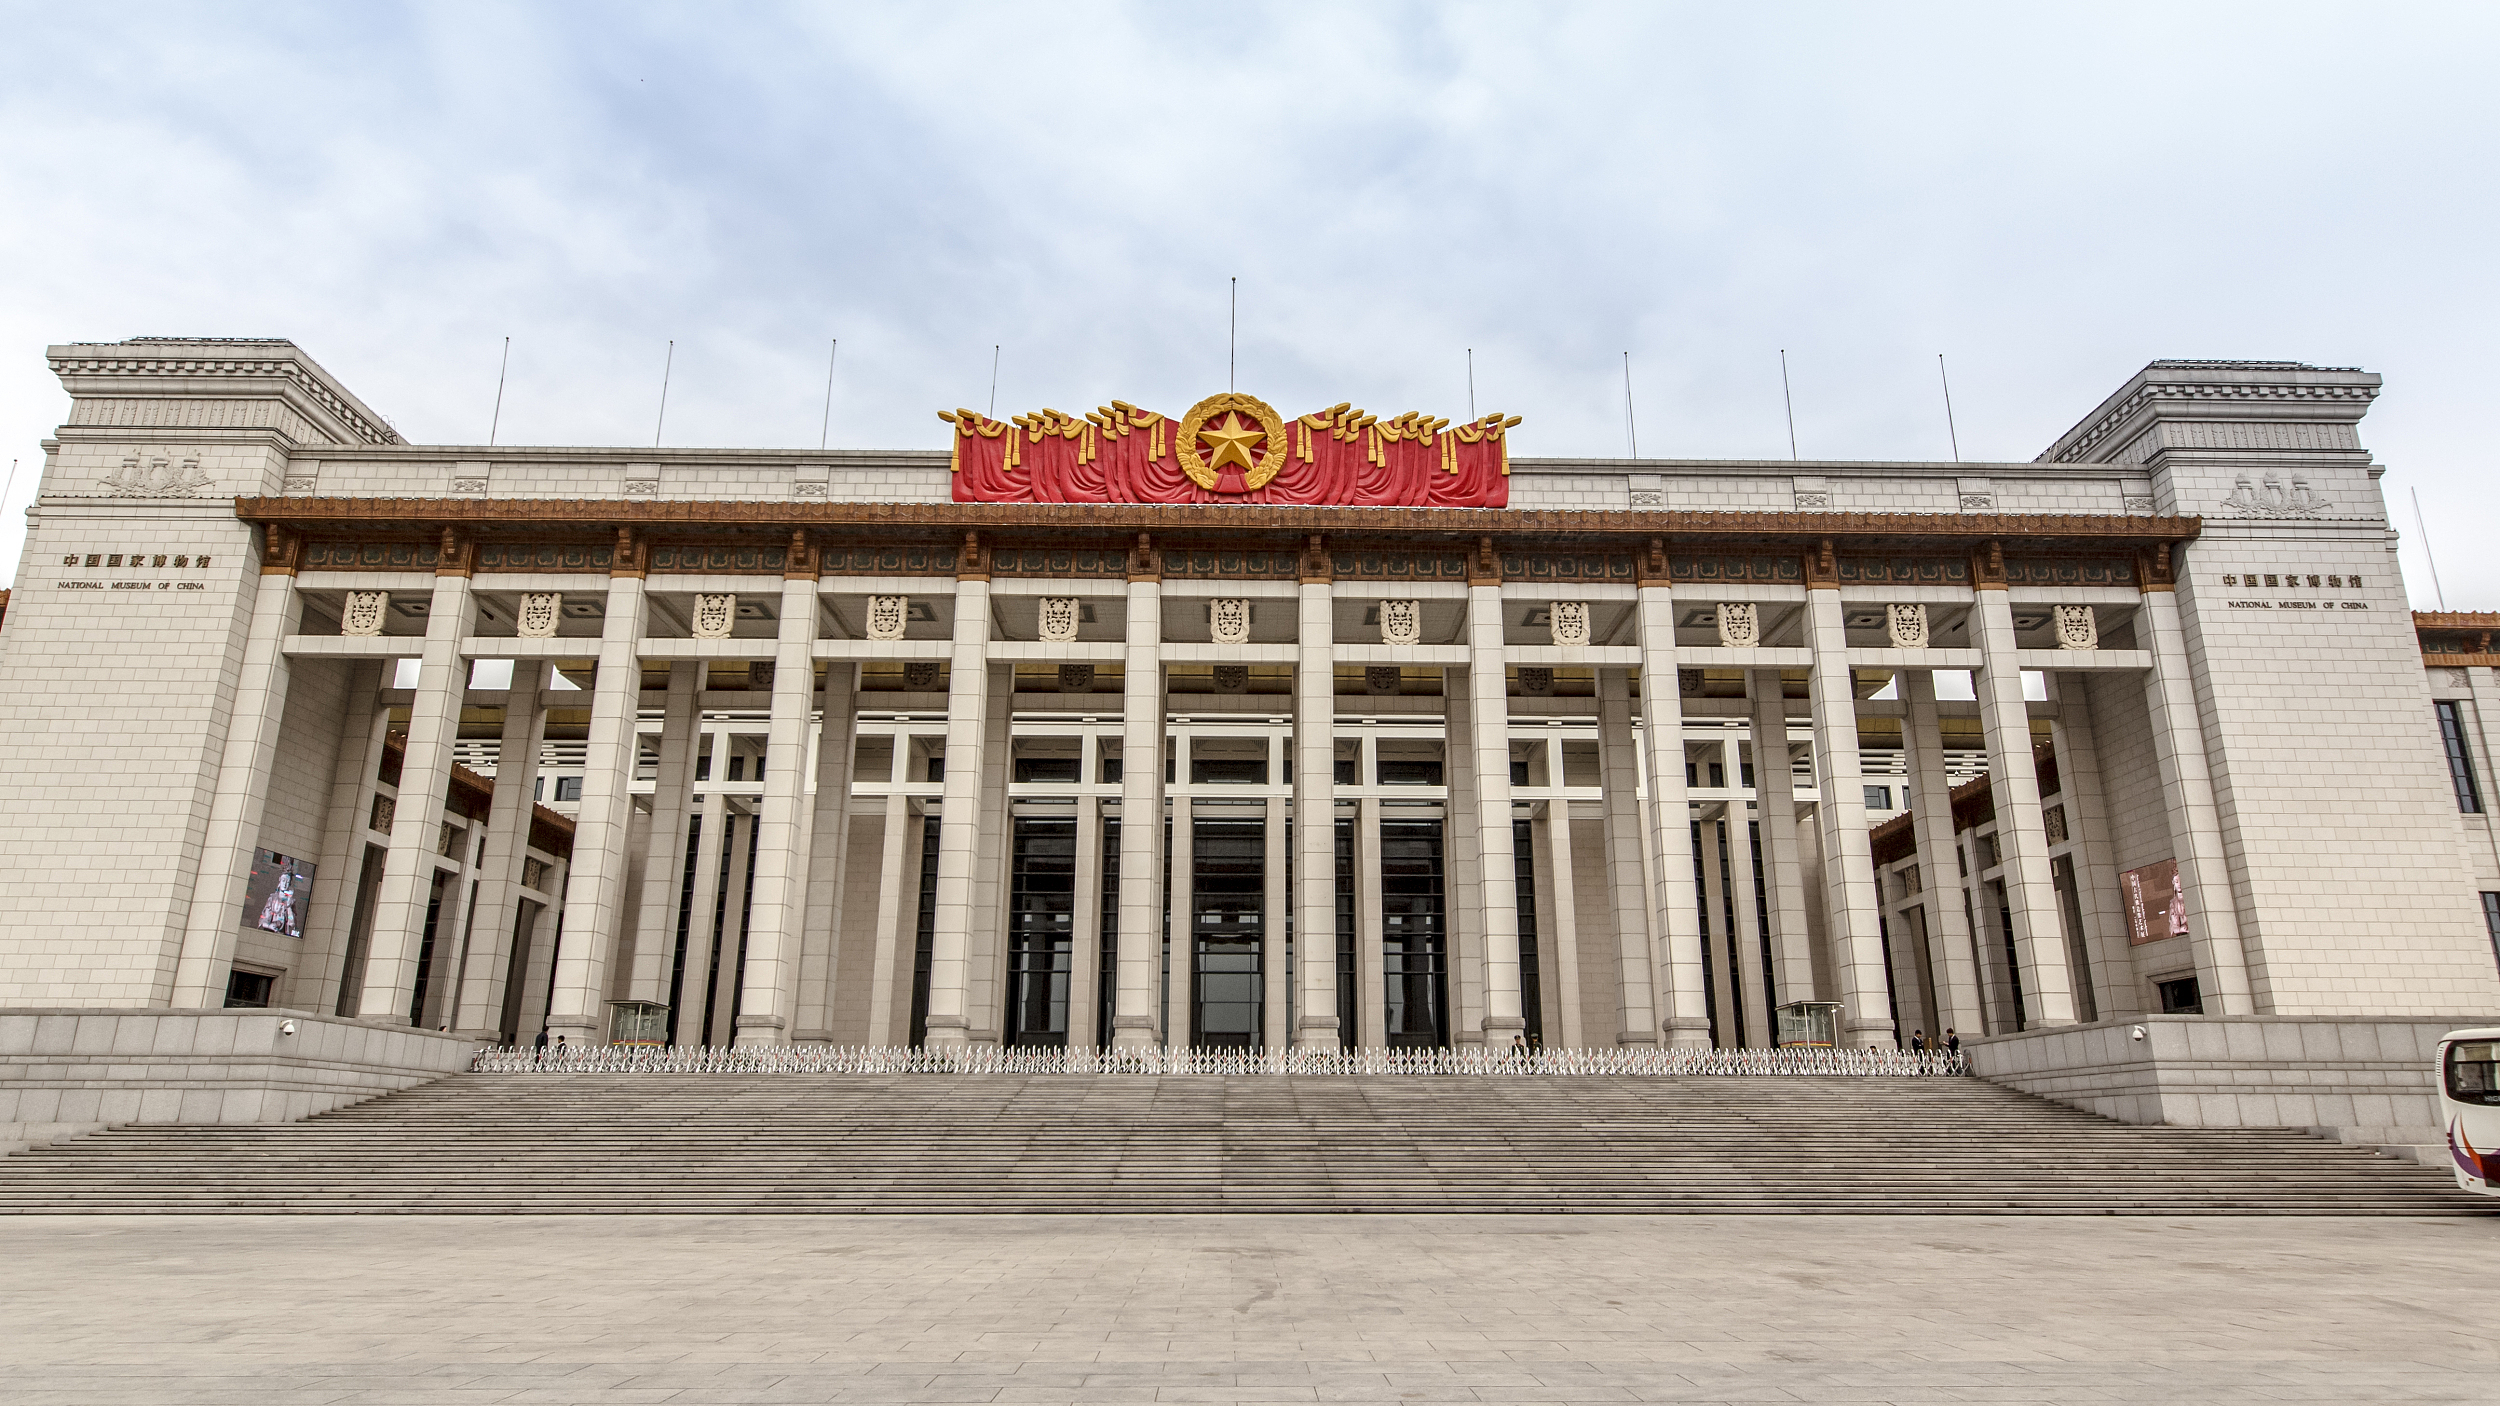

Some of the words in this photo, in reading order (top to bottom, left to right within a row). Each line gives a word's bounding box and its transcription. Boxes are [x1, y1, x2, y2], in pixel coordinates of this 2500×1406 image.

[63, 553, 211, 568] 中国国家博物馆
[57, 581, 104, 590] NATIONAL
[111, 582, 151, 590] MUSEUM
[158, 582, 170, 590] OF
[176, 582, 205, 590] CHINA
[2223, 573, 2362, 588] 中国国家博物馆
[2228, 601, 2272, 609] NATIONAL
[2278, 601, 2316, 609] MUSEUM
[2340, 602, 2368, 610] CHINA
